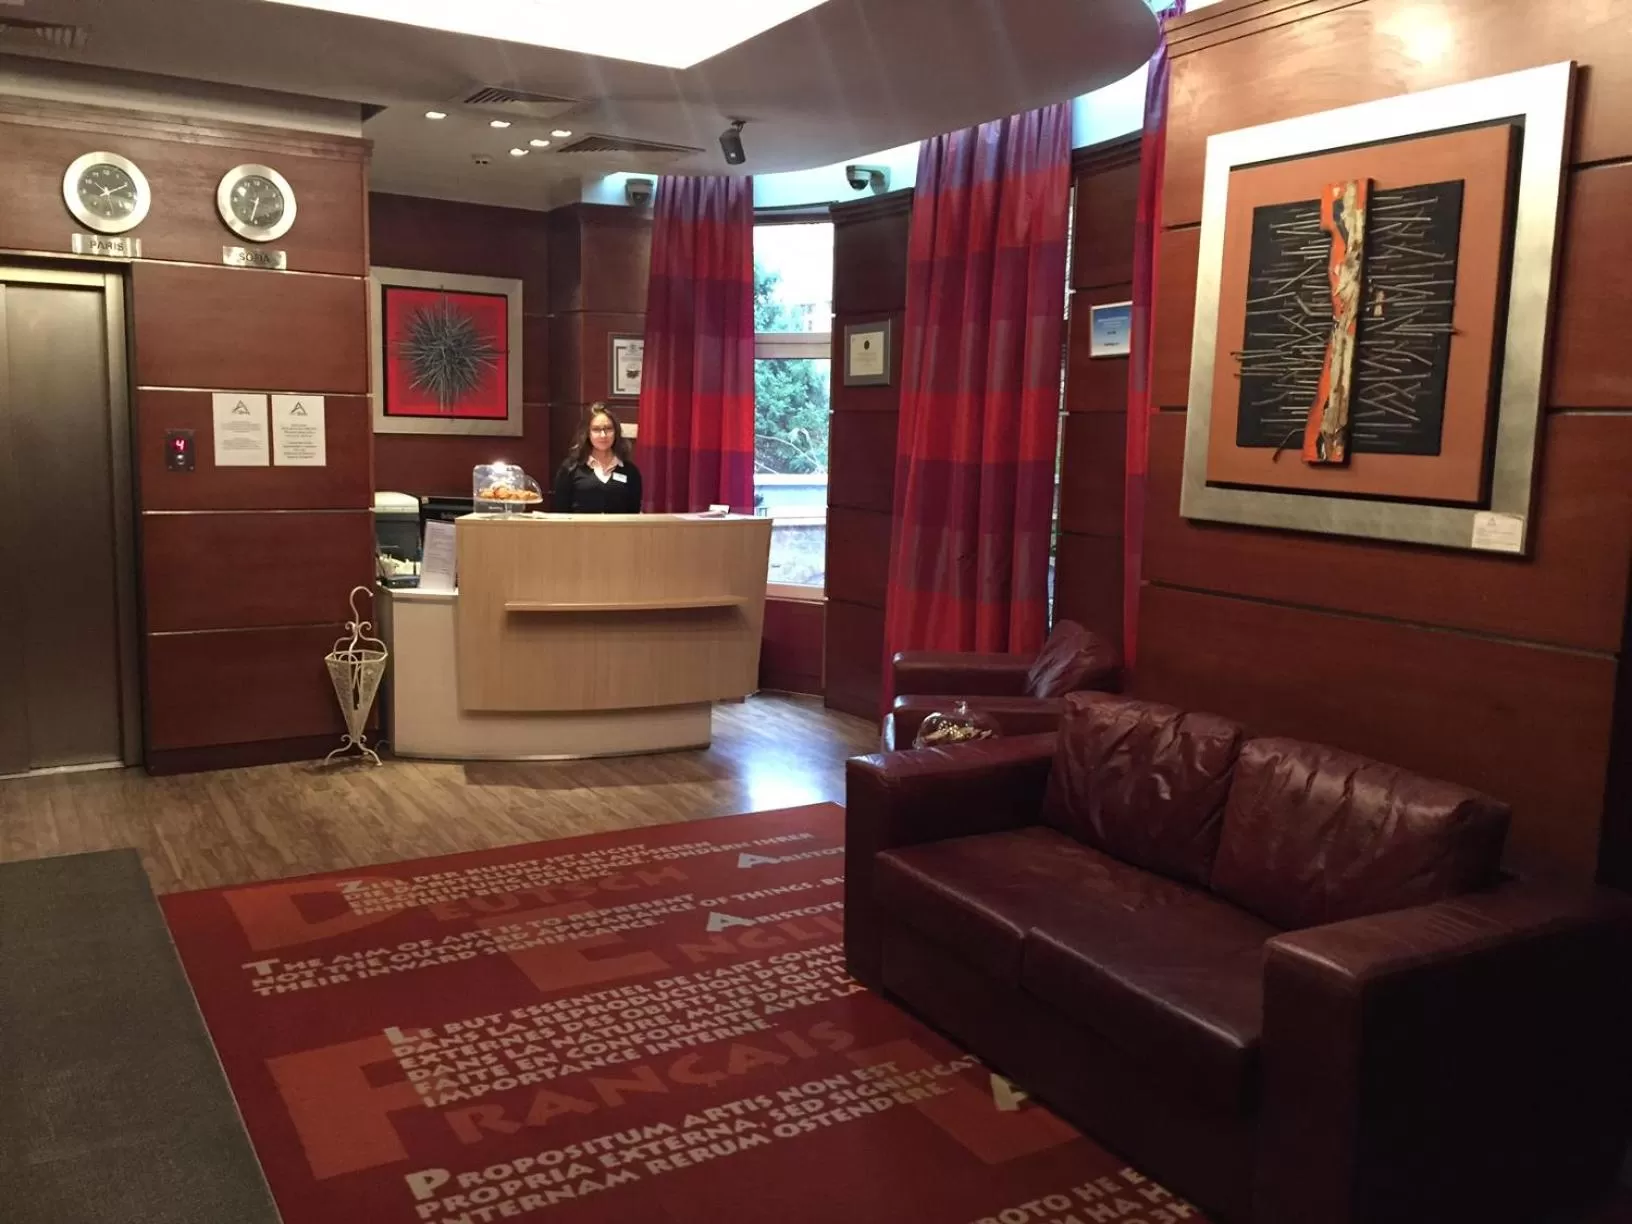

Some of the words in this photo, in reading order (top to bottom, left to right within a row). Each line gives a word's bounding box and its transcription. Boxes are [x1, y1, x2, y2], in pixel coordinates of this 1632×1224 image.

[89, 240, 125, 251] PARIS
[239, 252, 270, 263] SOFIA
[175, 439, 185, 451] 4
[412, 871, 460, 882] DER
[465, 860, 540, 875] KUNST
[544, 853, 576, 863] IST
[581, 844, 645, 858] NICHT
[527, 869, 572, 881] DER
[652, 842, 751, 860] SONDERN
[752, 833, 814, 845] IHRER
[560, 858, 605, 867] DER
[241, 958, 324, 976] THE
[331, 948, 392, 964] AIM
[397, 939, 434, 951] OF
[442, 928, 492, 944] ART
[498, 923, 523, 934] IS
[526, 917, 563, 928] TO
[567, 893, 695, 922] REPRESENT
[252, 969, 318, 987] NOT
[323, 957, 383, 974] THE
[389, 931, 530, 962] OUTWARD
[537, 901, 697, 937] APPEARANCE
[700, 896, 729, 907] OF
[252, 974, 350, 996] THEIR
[357, 950, 479, 979] INWARD
[383, 1026, 437, 1046] LE
[443, 1012, 503, 1035] BUT
[509, 984, 651, 1020] ESSENTIEL
[653, 975, 691, 989] DE
[693, 959, 763, 981] L'ART
[767, 942, 844, 964] CONSI
[391, 1031, 481, 1058] DANS
[485, 1022, 528, 1037] LA
[531, 974, 752, 1027] REPRODUCTION
[754, 962, 801, 980] DES
[400, 1027, 557, 1069] EXTERNES
[561, 1013, 618, 1034] DES
[619, 993, 718, 1020] OBJETS
[717, 980, 778, 998] TELS
[406, 1052, 499, 1082] DANS
[504, 1043, 548, 1060] LA
[686, 997, 757, 1020] MAIS
[758, 979, 832, 1003] DANS
[415, 1063, 511, 1095] FAITE
[515, 1052, 560, 1072] EN
[764, 992, 831, 1015] AVEC
[831, 984, 869, 997] LA
[423, 1047, 642, 1108] IMPORTANCE
[404, 1121, 677, 1201] PROPOSITUM
[682, 1094, 773, 1129] ARTIS
[776, 1073, 852, 1099] NON
[851, 1061, 900, 1082] EST
[414, 1162, 595, 1220] PROPRIA
[768, 1097, 827, 1122] SED
[644, 1132, 773, 1176] RERUM
